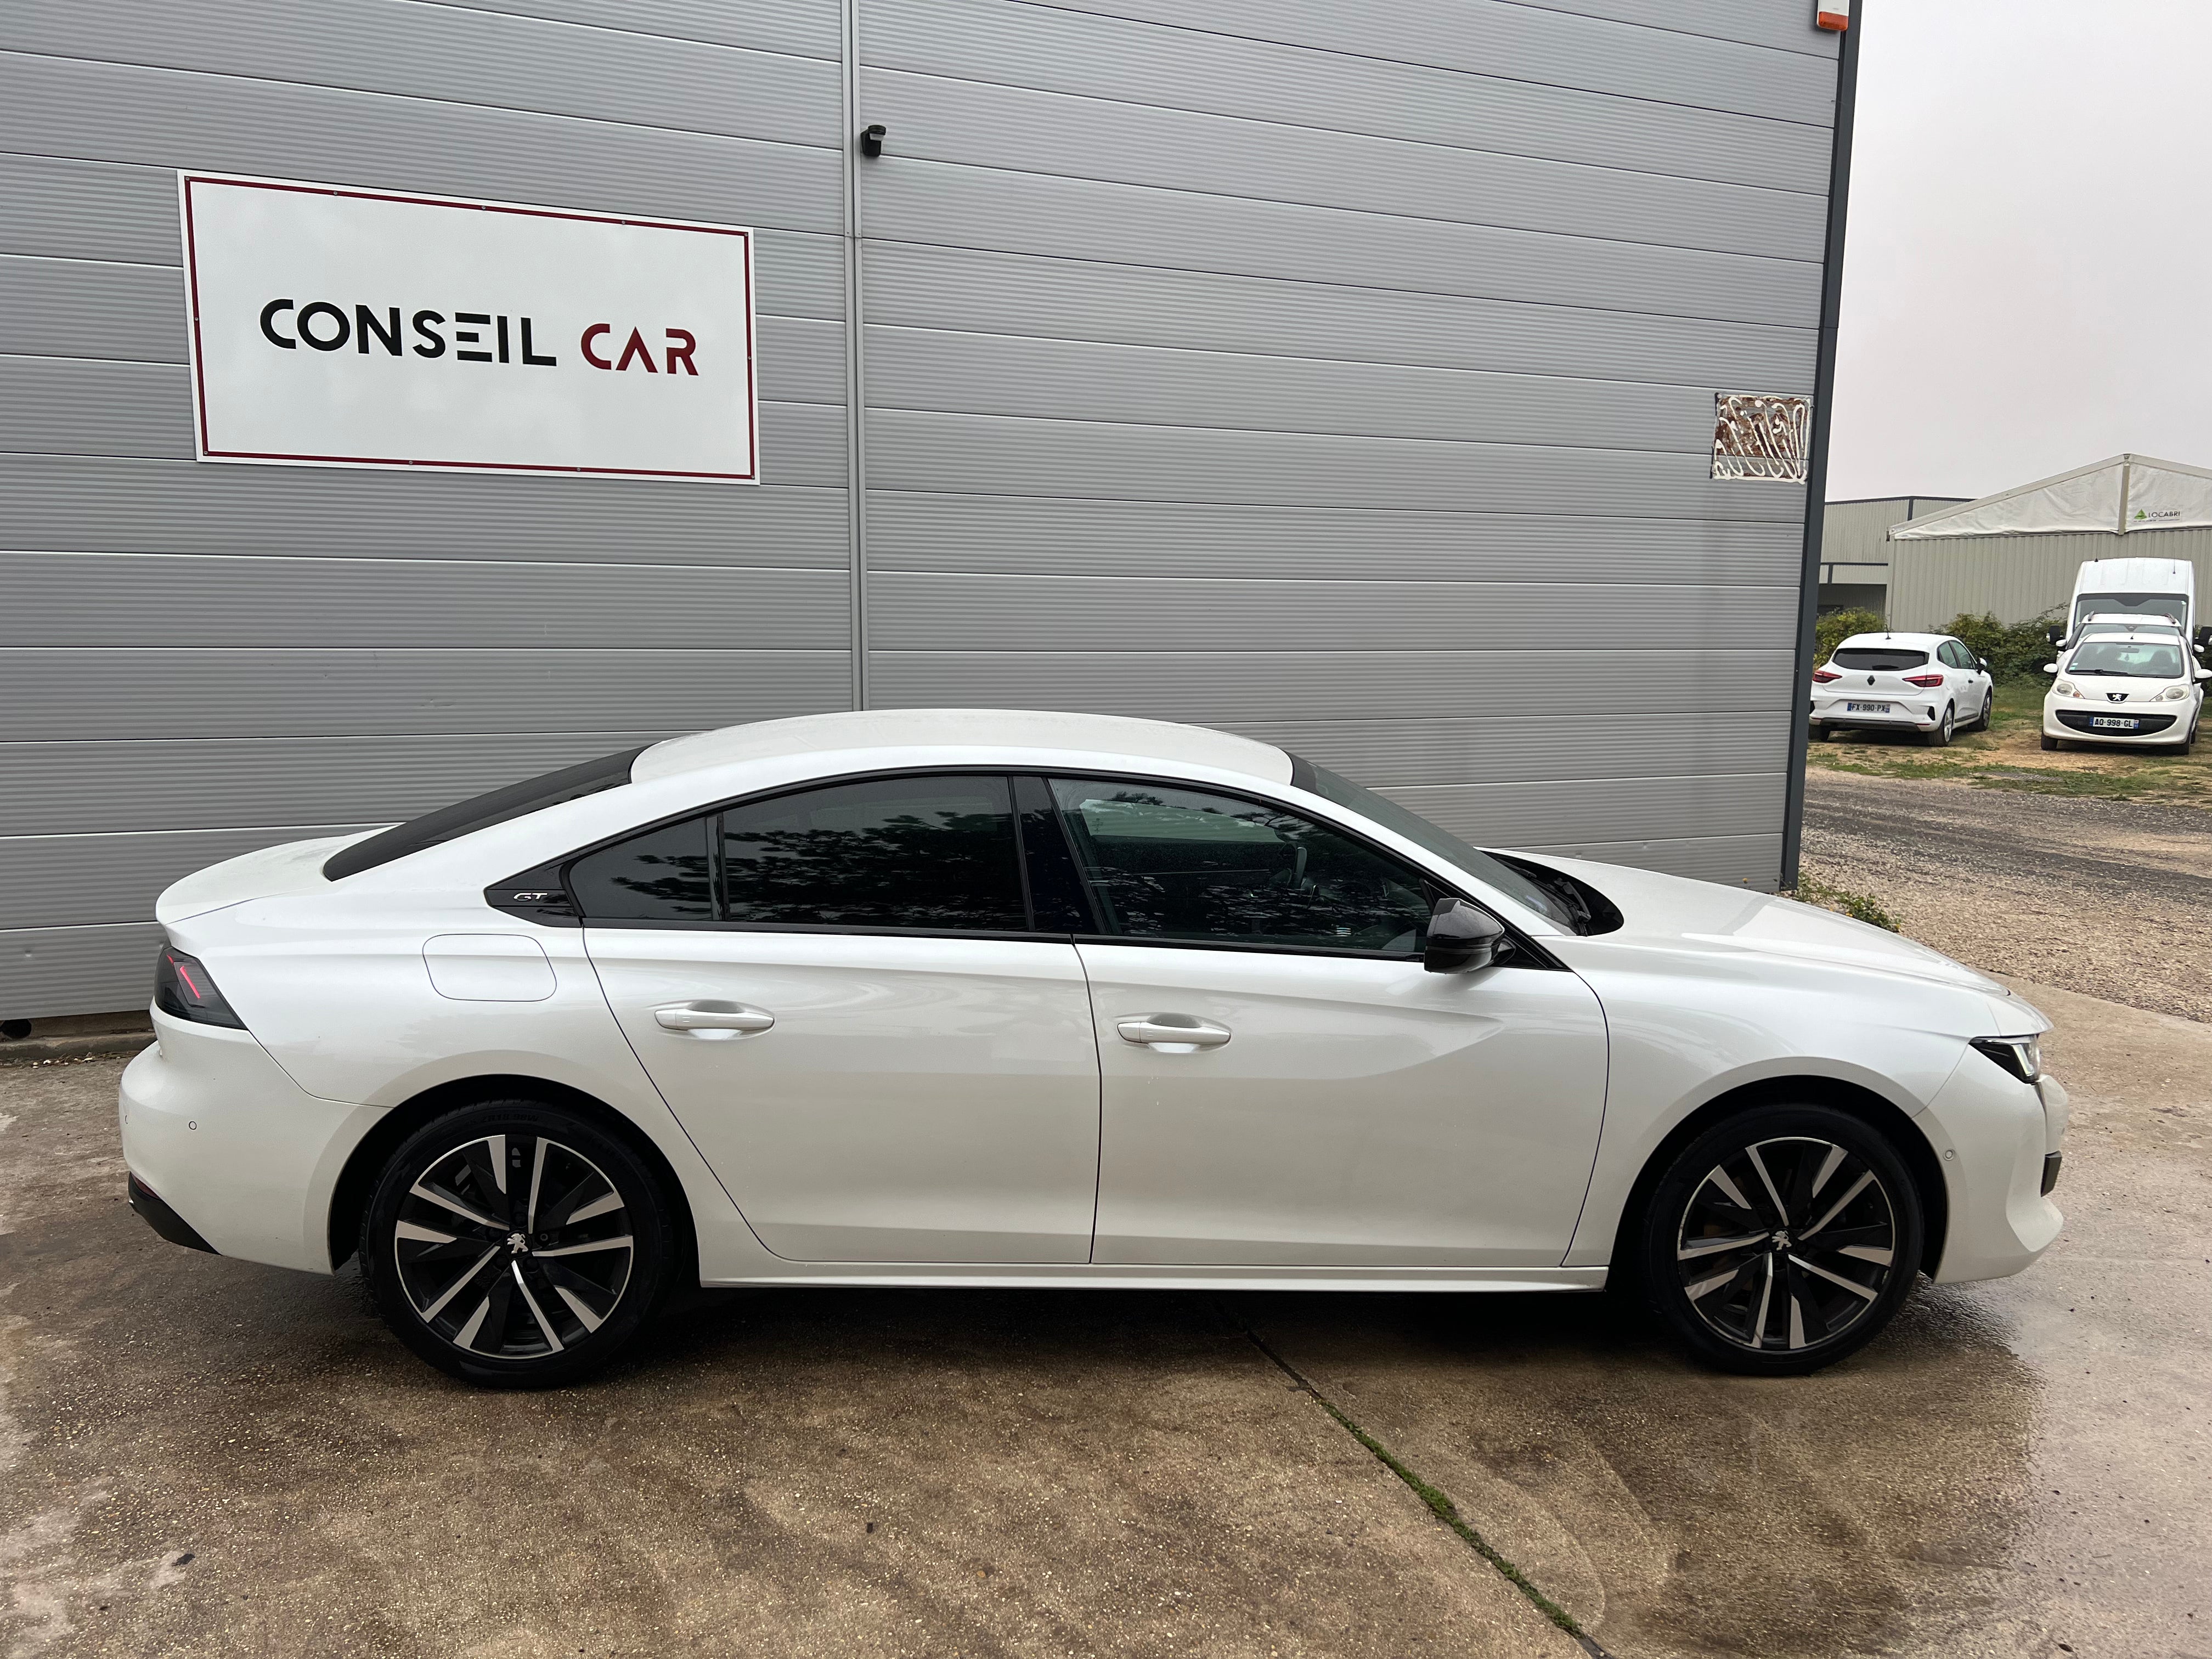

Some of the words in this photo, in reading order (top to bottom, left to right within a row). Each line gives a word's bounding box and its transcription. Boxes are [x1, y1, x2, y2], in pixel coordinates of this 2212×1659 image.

[259, 298, 557, 366] CONSEIL
[581, 323, 698, 376] CAR
[514, 893, 548, 901] GT
